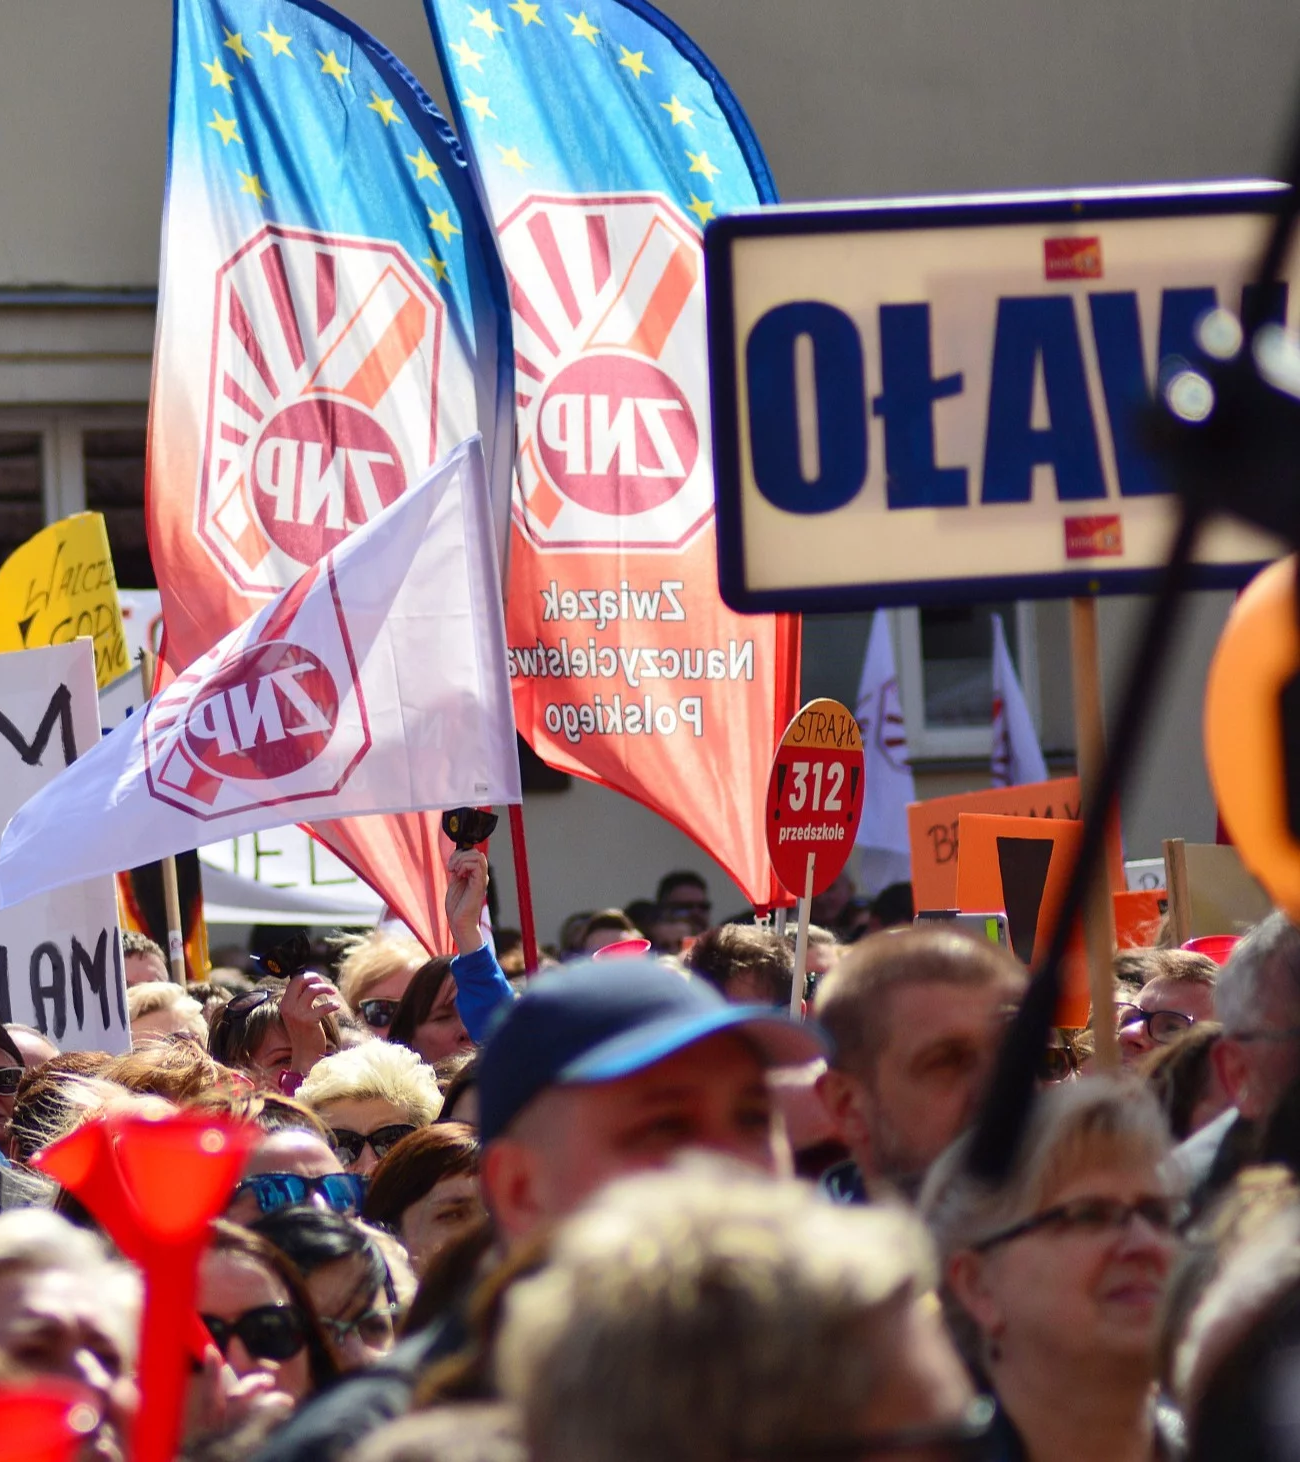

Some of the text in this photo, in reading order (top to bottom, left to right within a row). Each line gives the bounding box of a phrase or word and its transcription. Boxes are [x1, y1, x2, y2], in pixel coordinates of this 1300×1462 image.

[792, 711, 857, 747] STRAJK
[788, 761, 846, 812] 312
[778, 822, 846, 845] przedszkole
